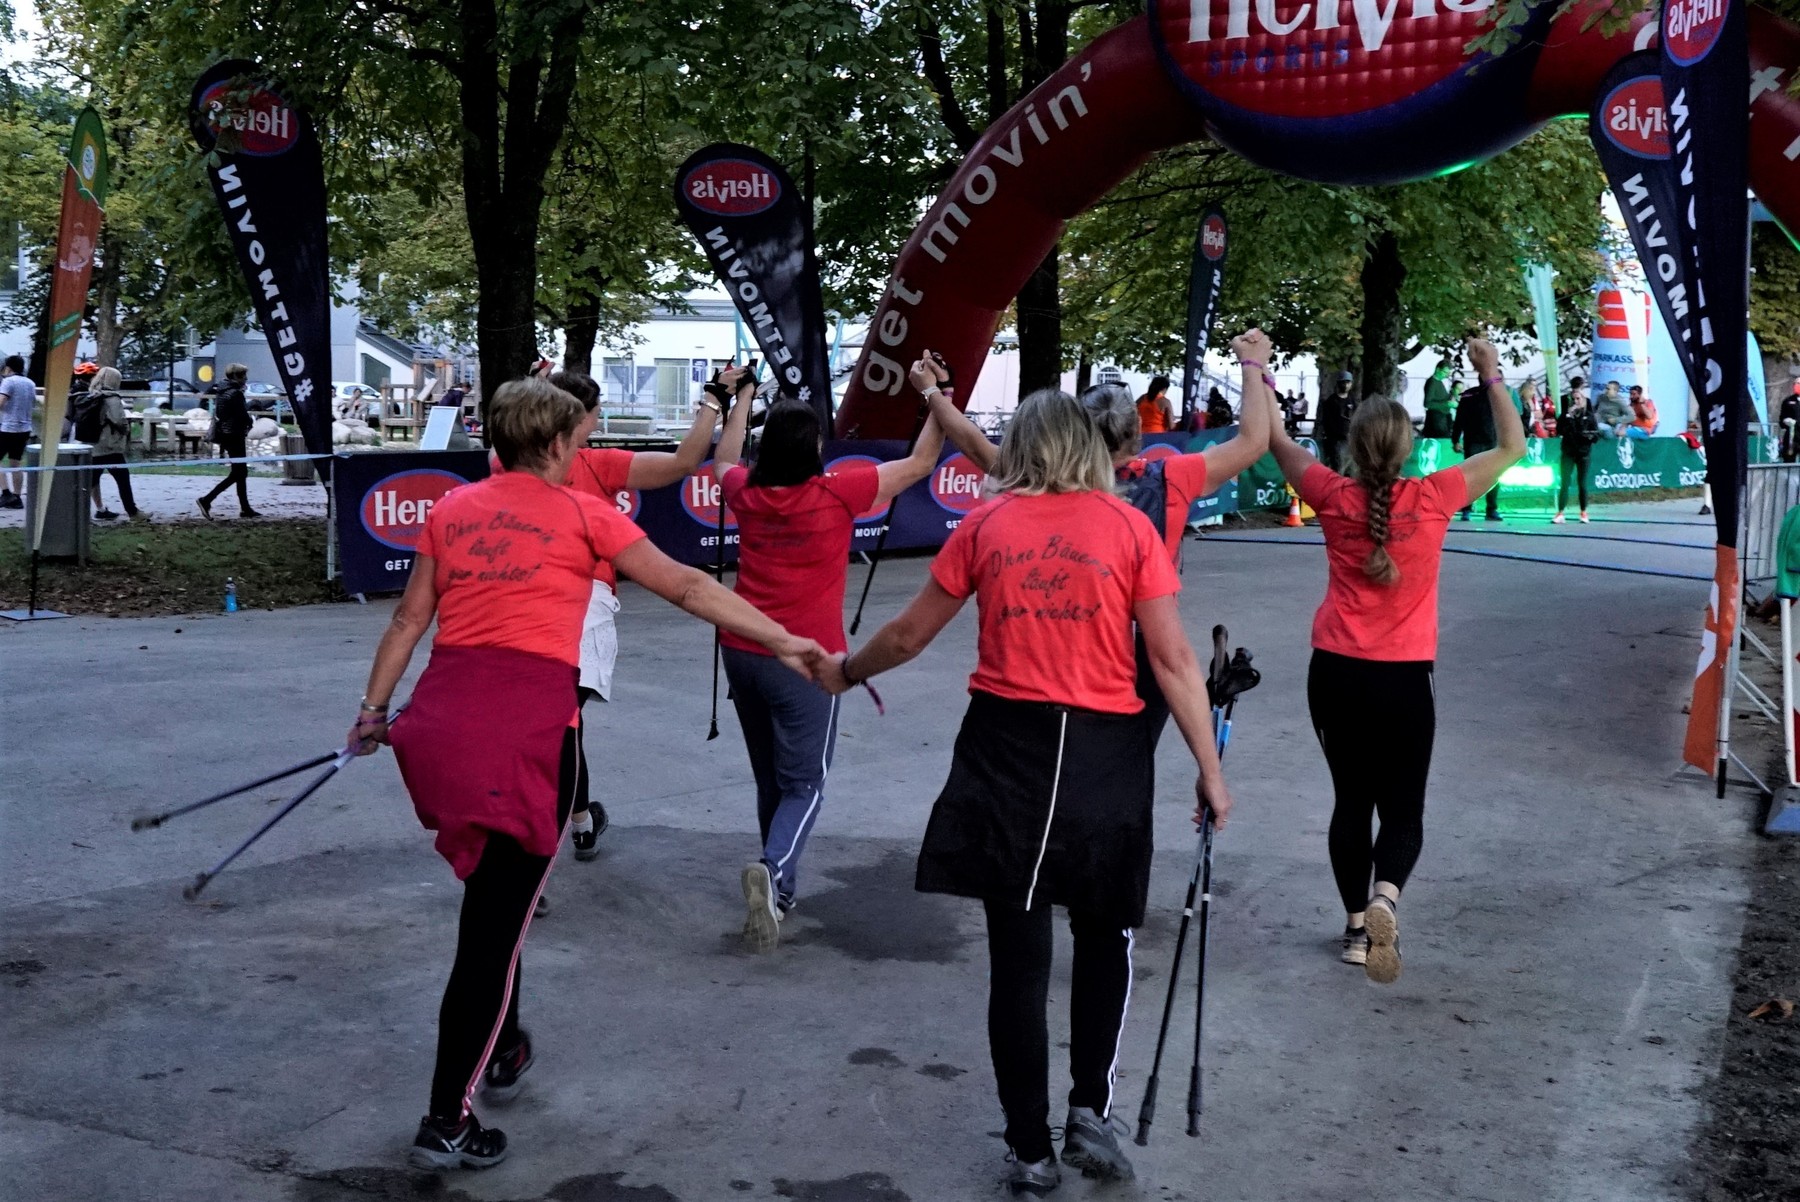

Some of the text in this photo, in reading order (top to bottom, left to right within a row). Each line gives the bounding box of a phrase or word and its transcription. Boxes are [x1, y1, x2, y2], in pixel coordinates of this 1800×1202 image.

[1207, 41, 1348, 77] SPORTS
[862, 276, 924, 397] get
[938, 466, 984, 499] Herv
[374, 490, 434, 527] Her
[855, 527, 883, 538] MOVI
[384, 558, 411, 571] GET
[991, 546, 1037, 578] Ohne
